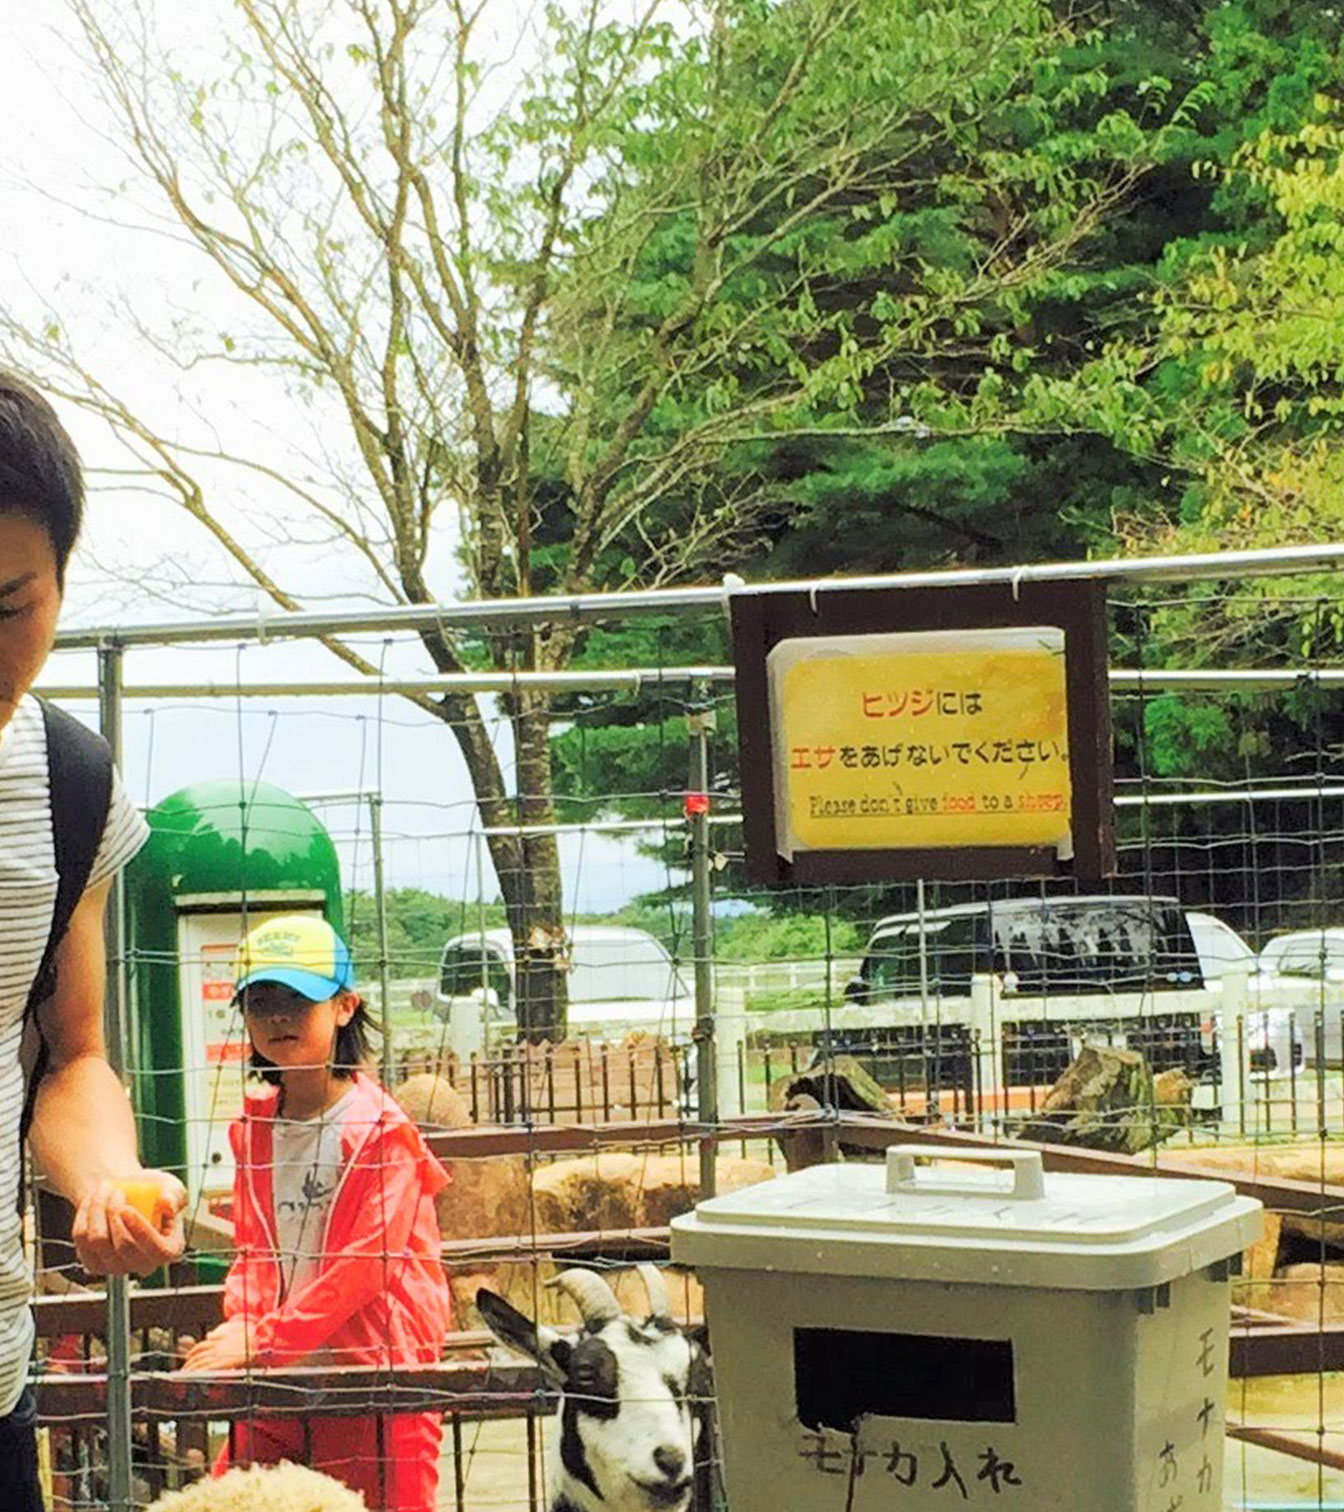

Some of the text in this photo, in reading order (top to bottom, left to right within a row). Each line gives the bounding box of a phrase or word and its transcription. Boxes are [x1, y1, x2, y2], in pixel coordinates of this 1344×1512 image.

[863, 690, 983, 718] ヒツジには
[808, 796, 856, 815] Please
[905, 794, 938, 814] give
[942, 792, 976, 812] food
[981, 793, 998, 809] to
[1003, 794, 1014, 808] a
[798, 1434, 1023, 1500] モナカ入れ
